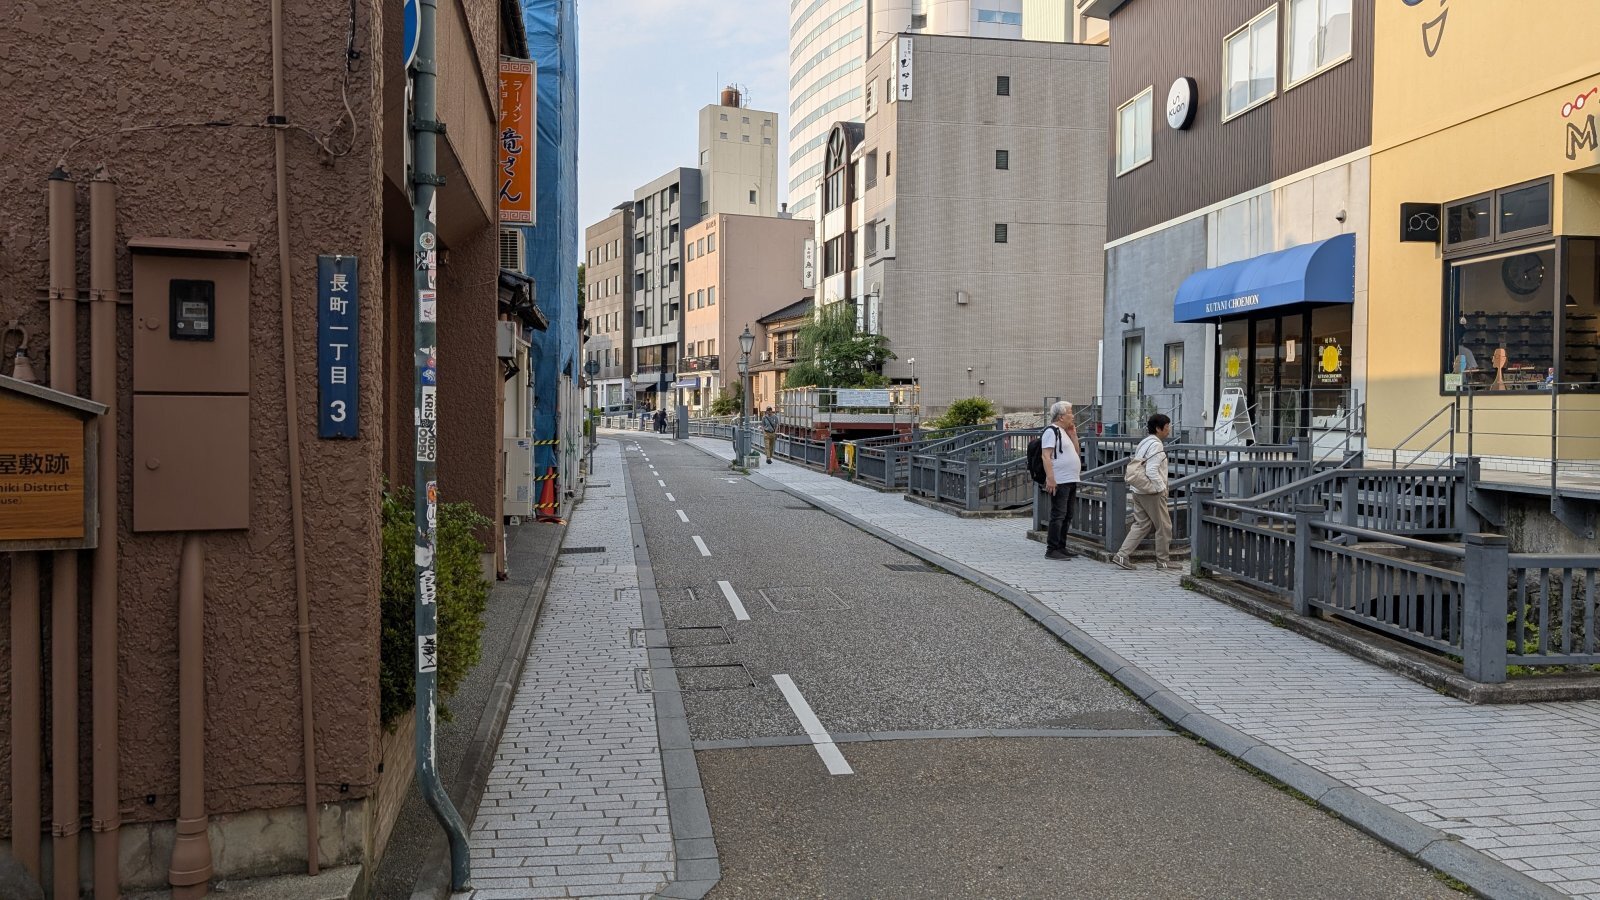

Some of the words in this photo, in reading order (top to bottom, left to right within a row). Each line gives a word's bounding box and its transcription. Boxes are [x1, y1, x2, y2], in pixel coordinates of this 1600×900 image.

[513, 80, 523, 122] ラーメン
[500, 128, 523, 202] 竜さん
[1205, 300, 1228, 313] KUTANI
[1228, 294, 1260, 309] CHOEMON
[329, 274, 349, 385] 長町一丁目
[330, 400, 347, 422] 3
[424, 393, 434, 419] KRIS
[419, 428, 427, 457] ODEN
[0, 453, 70, 475] 屋敷跡
[23, 482, 70, 493] District
